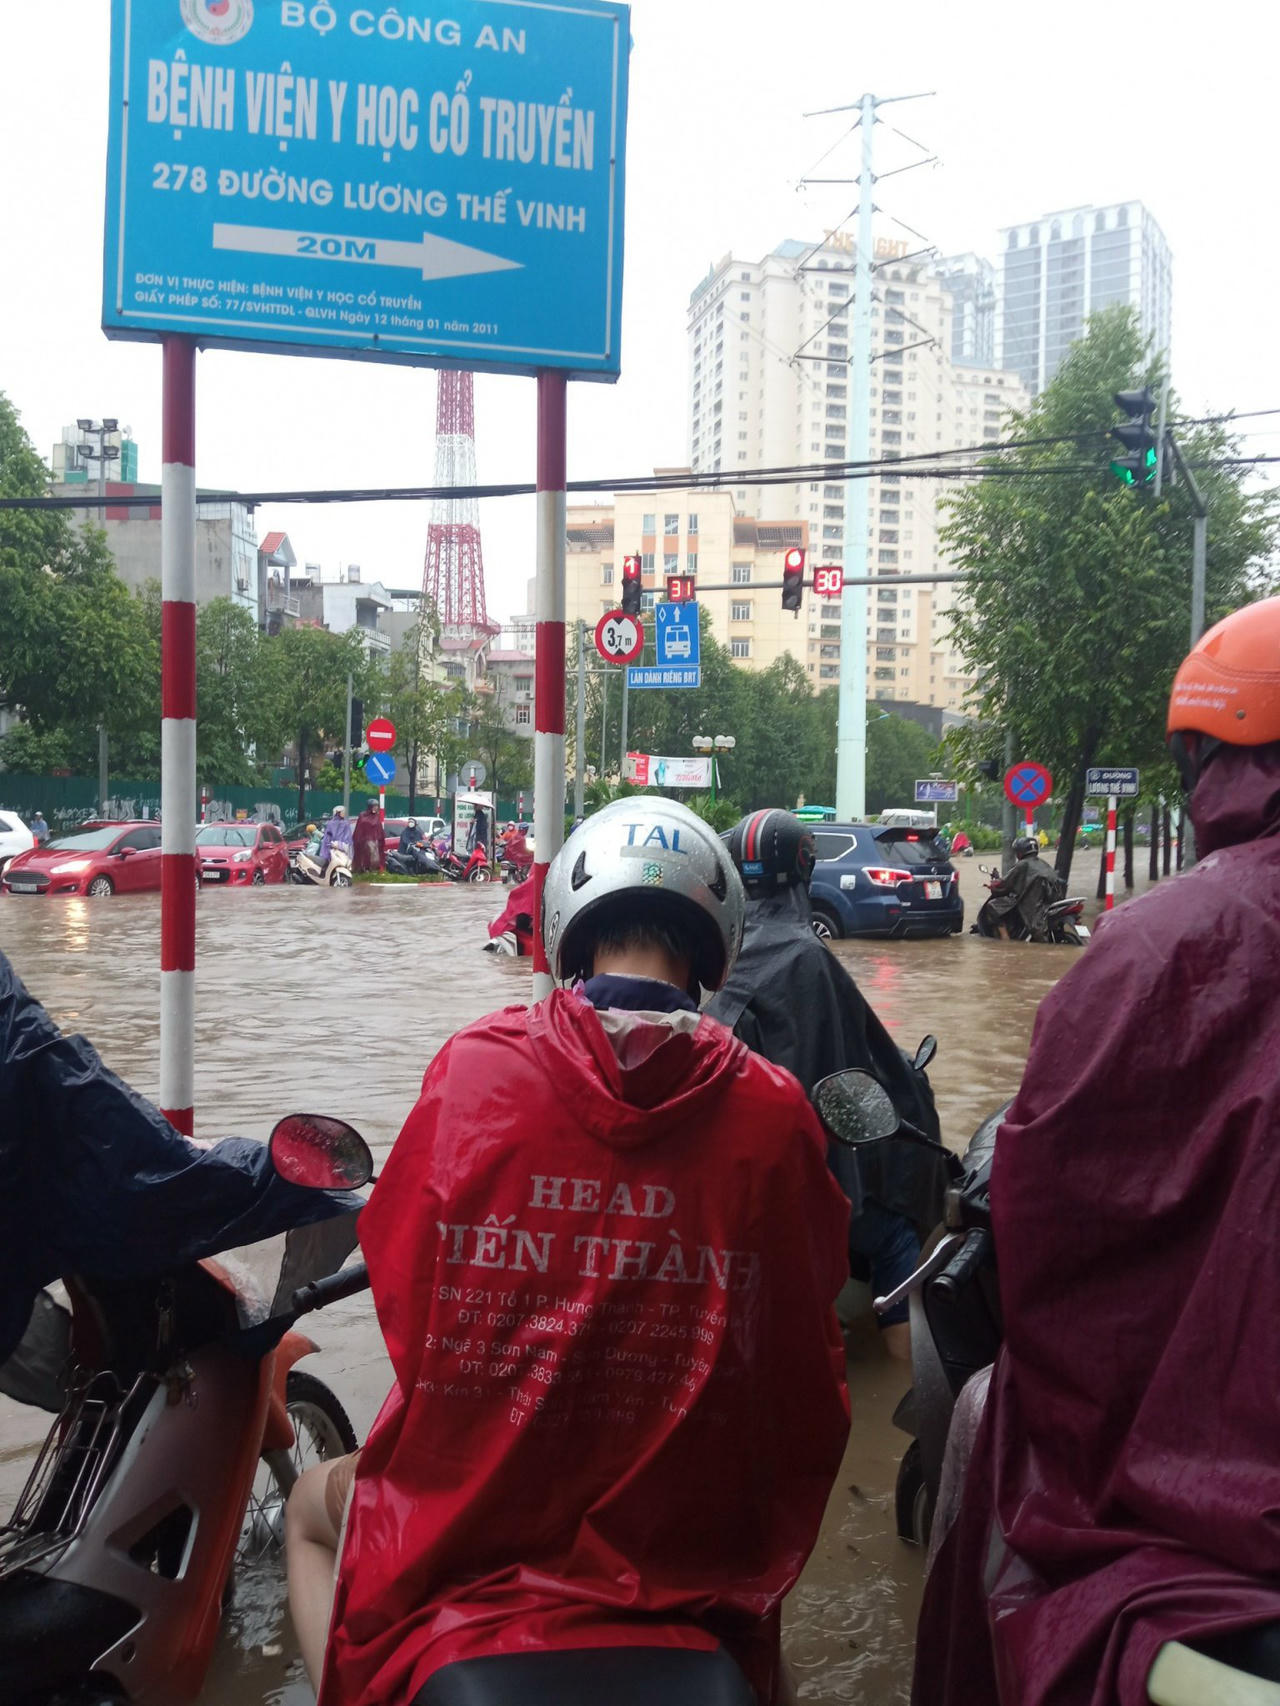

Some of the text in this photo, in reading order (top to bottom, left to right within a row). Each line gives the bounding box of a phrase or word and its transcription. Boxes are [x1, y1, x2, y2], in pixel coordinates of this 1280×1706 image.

[281, 0, 337, 36] BỘ
[349, 8, 462, 46] CÔNG
[475, 25, 526, 55] AN
[147, 49, 595, 171] BỆNH VIỆN Y HỌC CỔ TRUYỀN
[152, 163, 585, 232] 278 ĐƯỜNG LƯƠNG THẾ VINH
[296, 235, 376, 260] 20M
[135, 272, 163, 287] ĐƠN
[167, 275, 179, 290] VỊ
[182, 277, 215, 293] THỰC
[252, 282, 283, 299] BỆNH
[287, 285, 313, 302] VIỆN
[316, 290, 324, 301] Y
[327, 291, 354, 306] HỌC
[135, 288, 165, 304] GIẤY
[168, 293, 198, 307] PHÉP
[339, 311, 371, 326] Ngày
[374, 313, 387, 325] 12
[391, 315, 424, 331] tháng
[427, 318, 440, 330] 01
[444, 320, 469, 333] năm
[472, 322, 498, 335] 2011
[670, 579, 692, 598] 31
[817, 569, 841, 592] 30
[622, 823, 688, 855] TAL
[528, 1175, 676, 1219] HEAD
[438, 1286, 461, 1302] SN
[465, 1288, 492, 1305] 221
[554, 1297, 593, 1319] Hưng
[476, 1340, 486, 1354] 3
